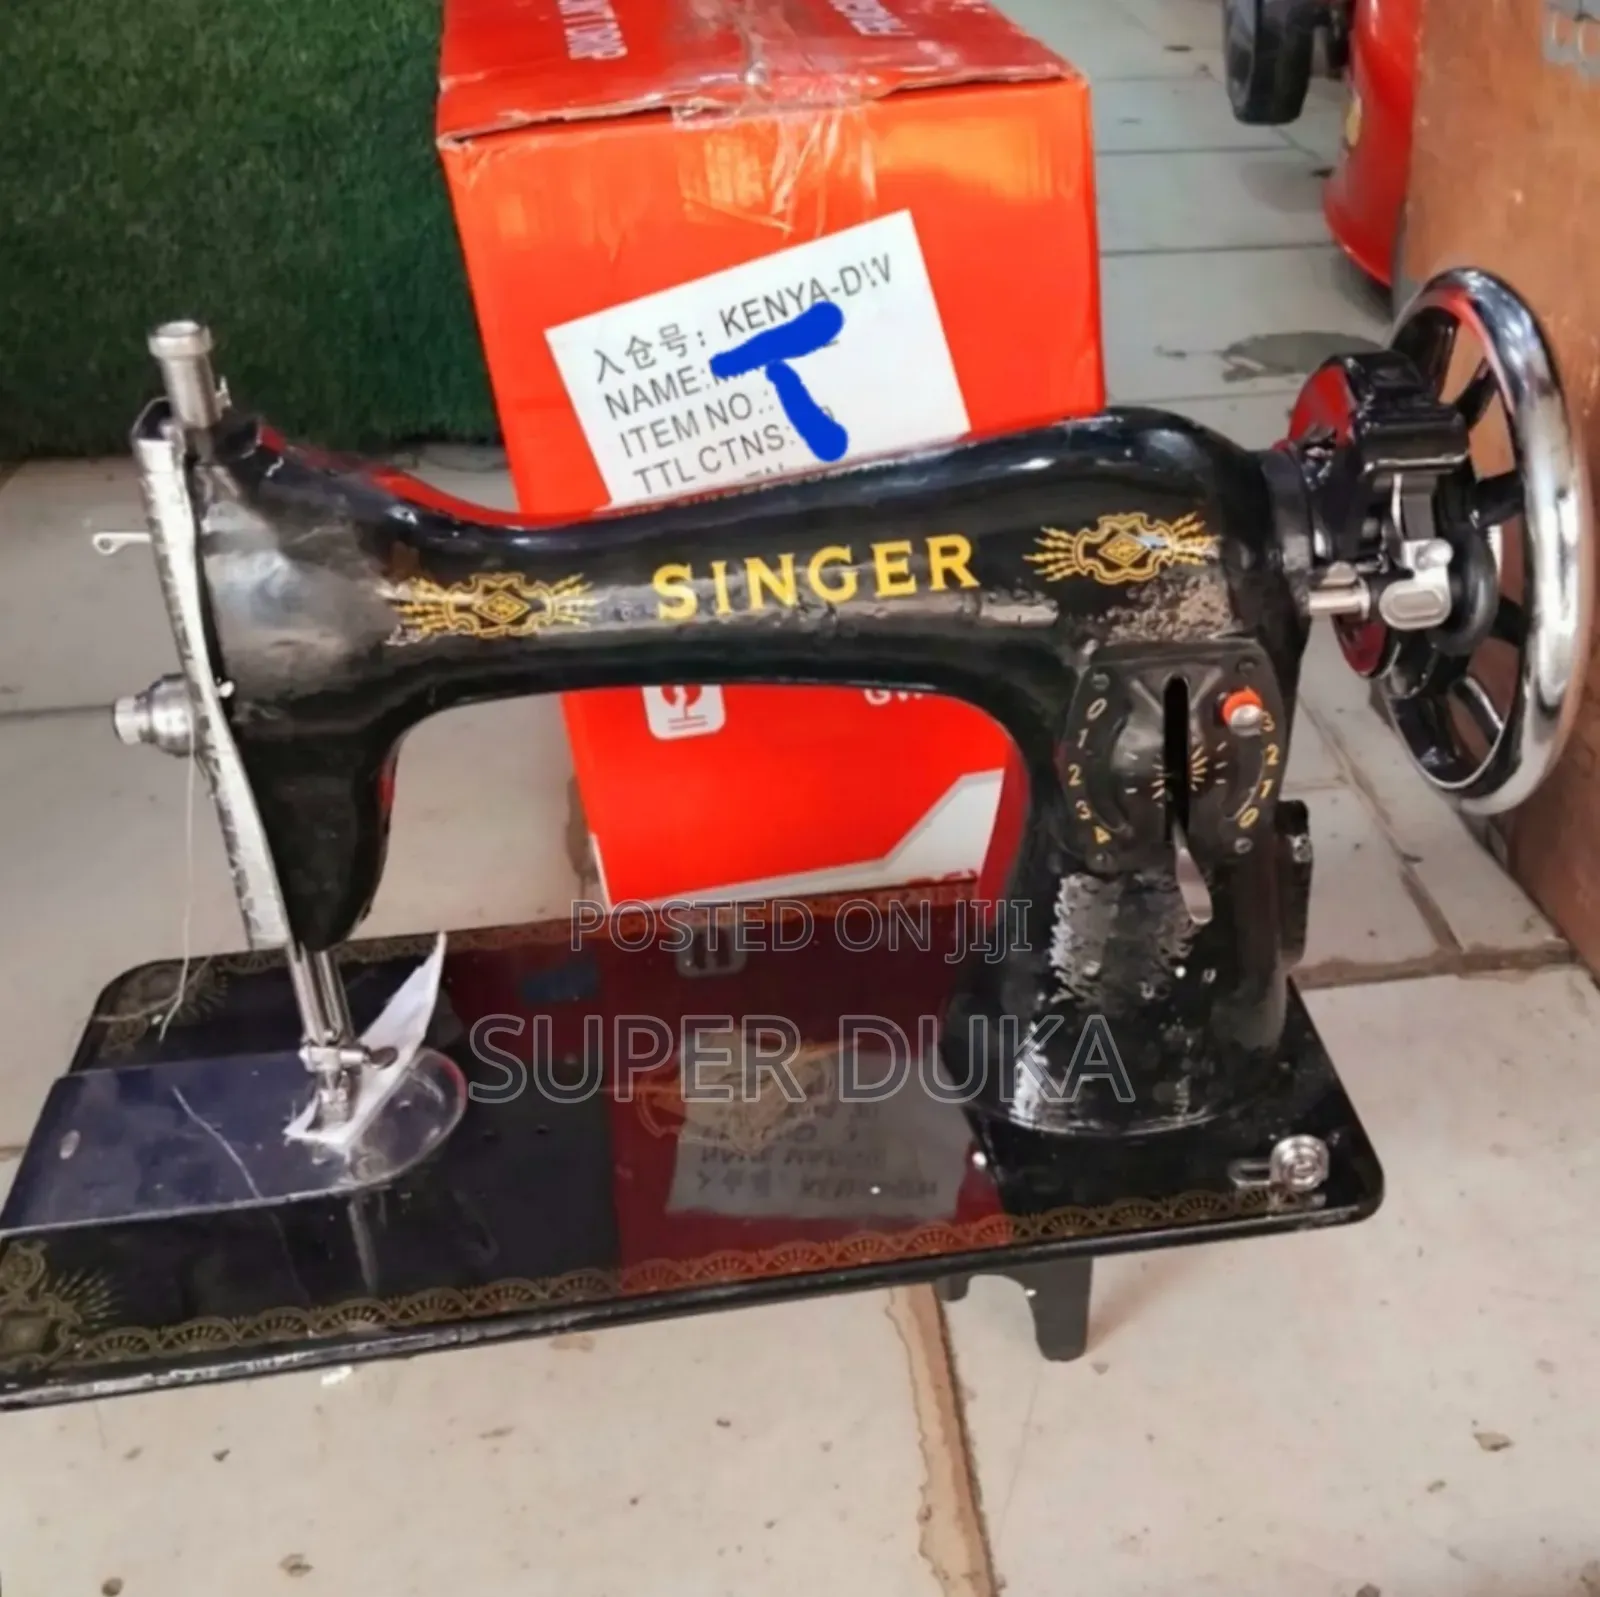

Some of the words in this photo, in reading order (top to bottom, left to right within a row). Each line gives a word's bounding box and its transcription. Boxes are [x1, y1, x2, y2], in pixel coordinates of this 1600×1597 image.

[619, 409, 700, 459] ITEM
[632, 457, 696, 495] TTL
[651, 533, 981, 621] SINGER
[1266, 744, 1279, 766] 2
[1068, 764, 1082, 786] 2
[1075, 800, 1092, 820] 3
[1238, 807, 1259, 829] 0
